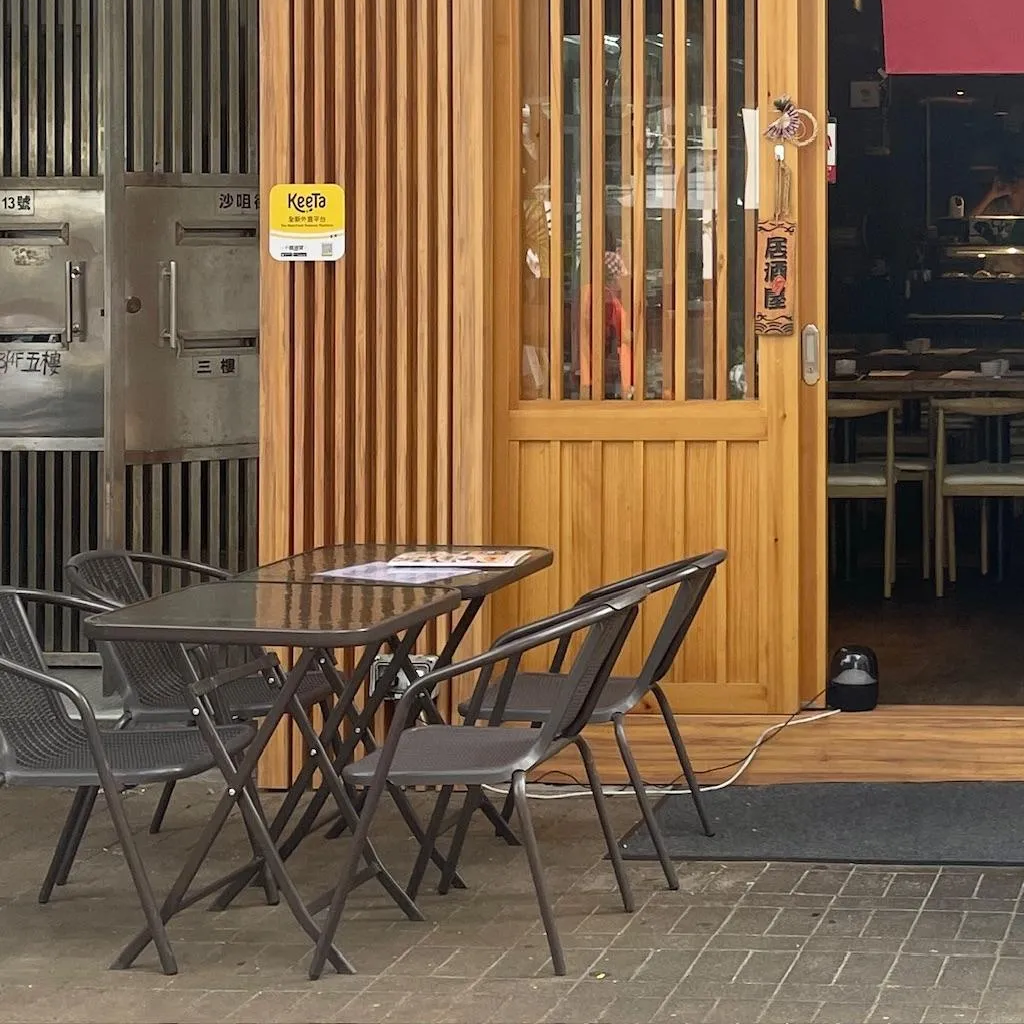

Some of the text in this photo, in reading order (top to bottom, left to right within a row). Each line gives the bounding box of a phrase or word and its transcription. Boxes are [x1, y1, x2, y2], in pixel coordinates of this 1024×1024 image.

[2, 195, 31, 211] 13號
[764, 237, 788, 310] 居酒屋
